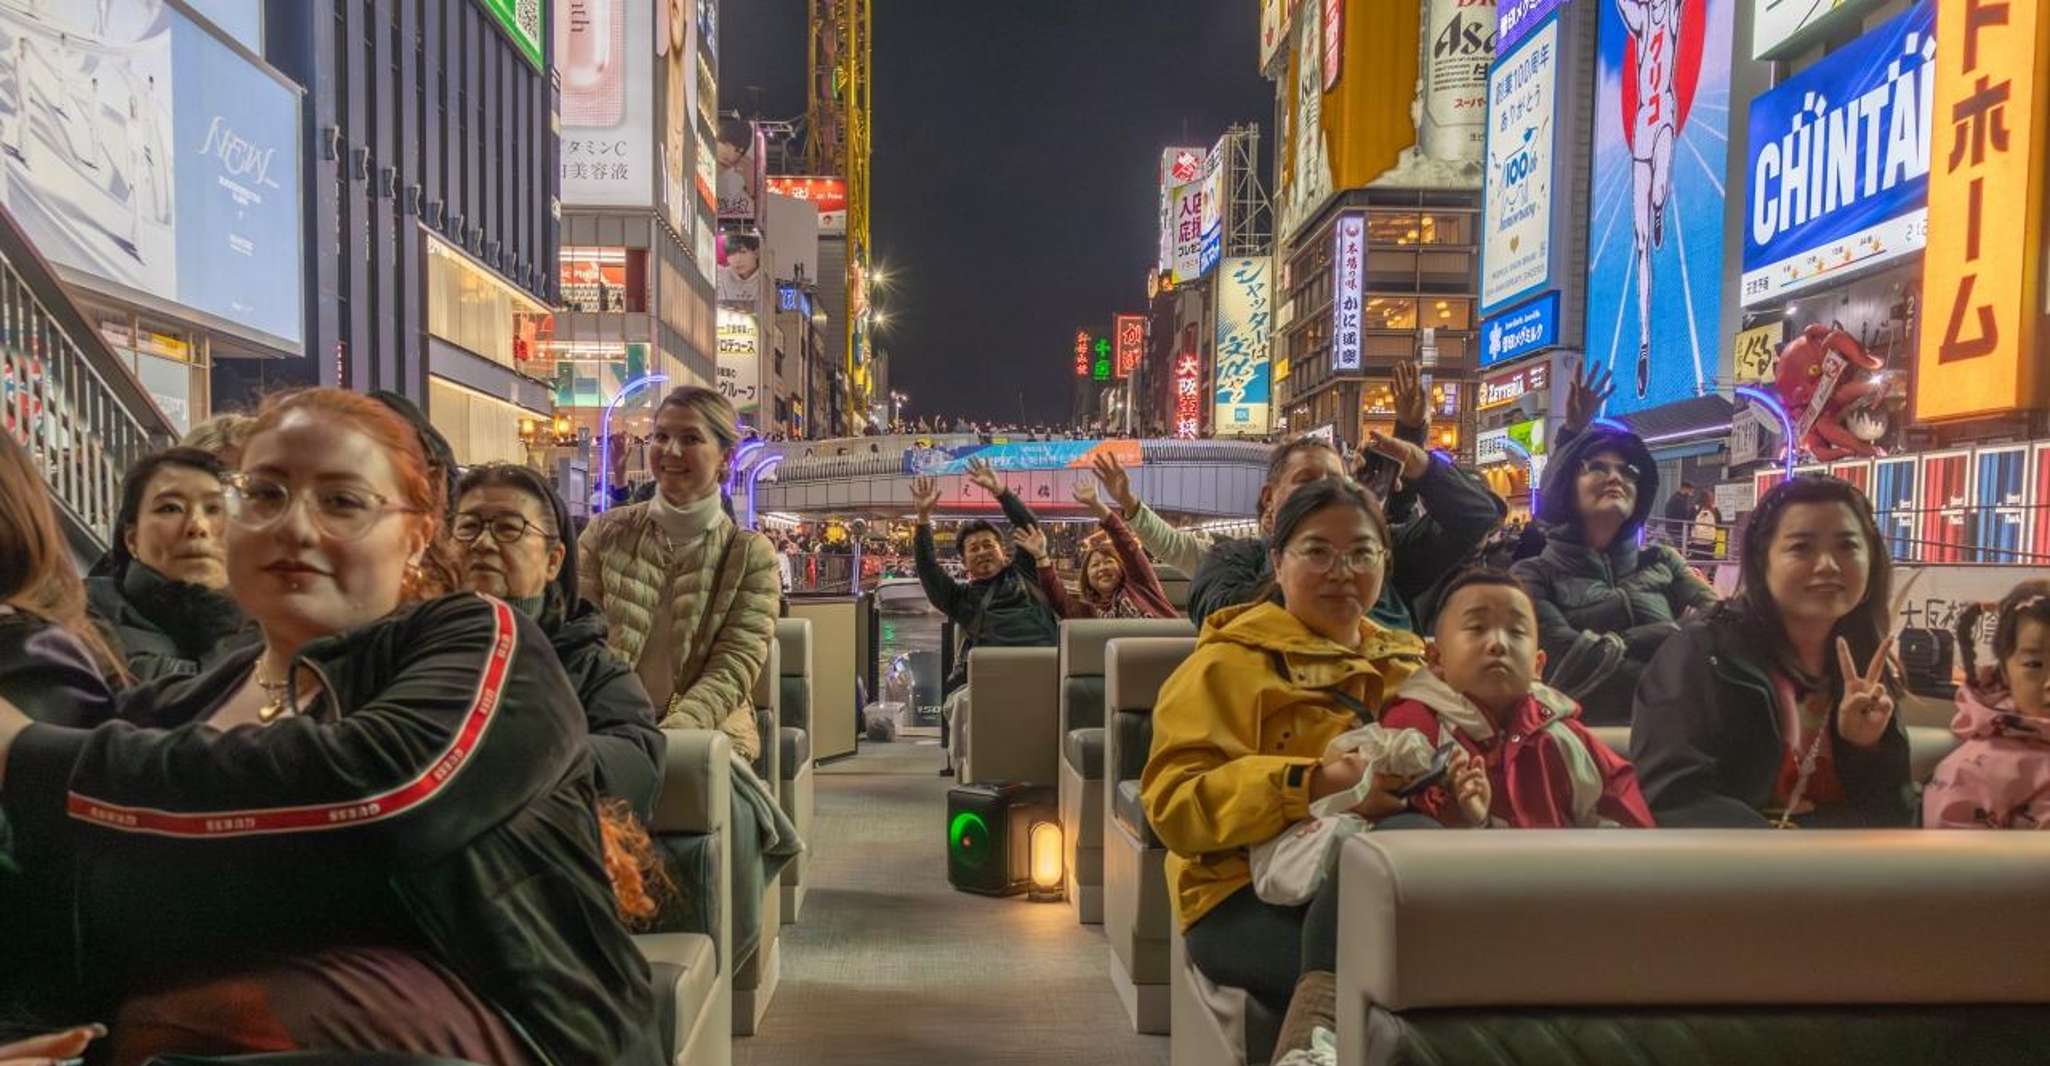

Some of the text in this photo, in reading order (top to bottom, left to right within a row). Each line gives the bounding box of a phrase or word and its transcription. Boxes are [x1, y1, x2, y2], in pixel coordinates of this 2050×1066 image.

[1647, 24, 1665, 126] グリコ
[1454, 96, 1487, 108] スーパ
[562, 162, 629, 180] 美容液
[1342, 296, 1358, 364] かに道楽
